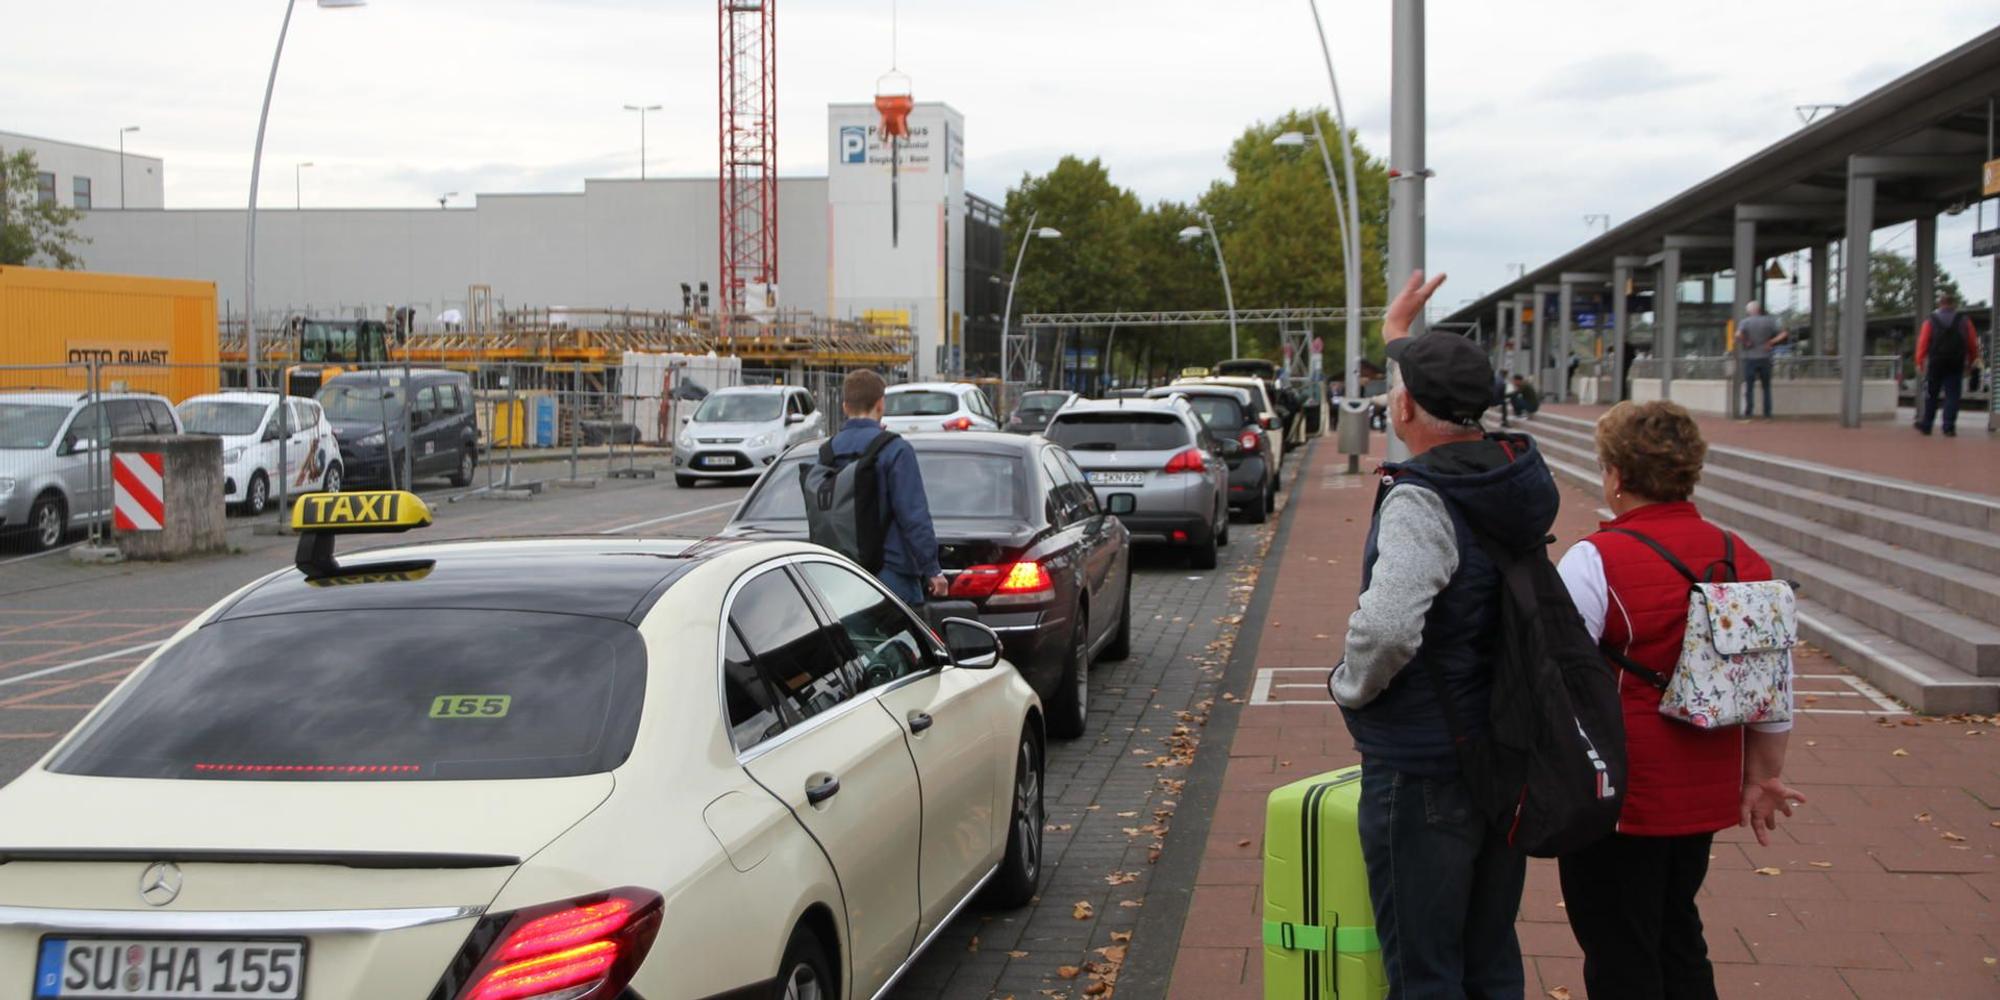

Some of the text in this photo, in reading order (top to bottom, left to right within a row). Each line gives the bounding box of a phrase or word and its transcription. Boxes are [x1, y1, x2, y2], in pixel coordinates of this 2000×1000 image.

[69, 349, 168, 364] OTTO QUAST
[311, 494, 392, 523] TAXI
[437, 699, 503, 715] 155
[65, 946, 297, 993] SU HA 155
